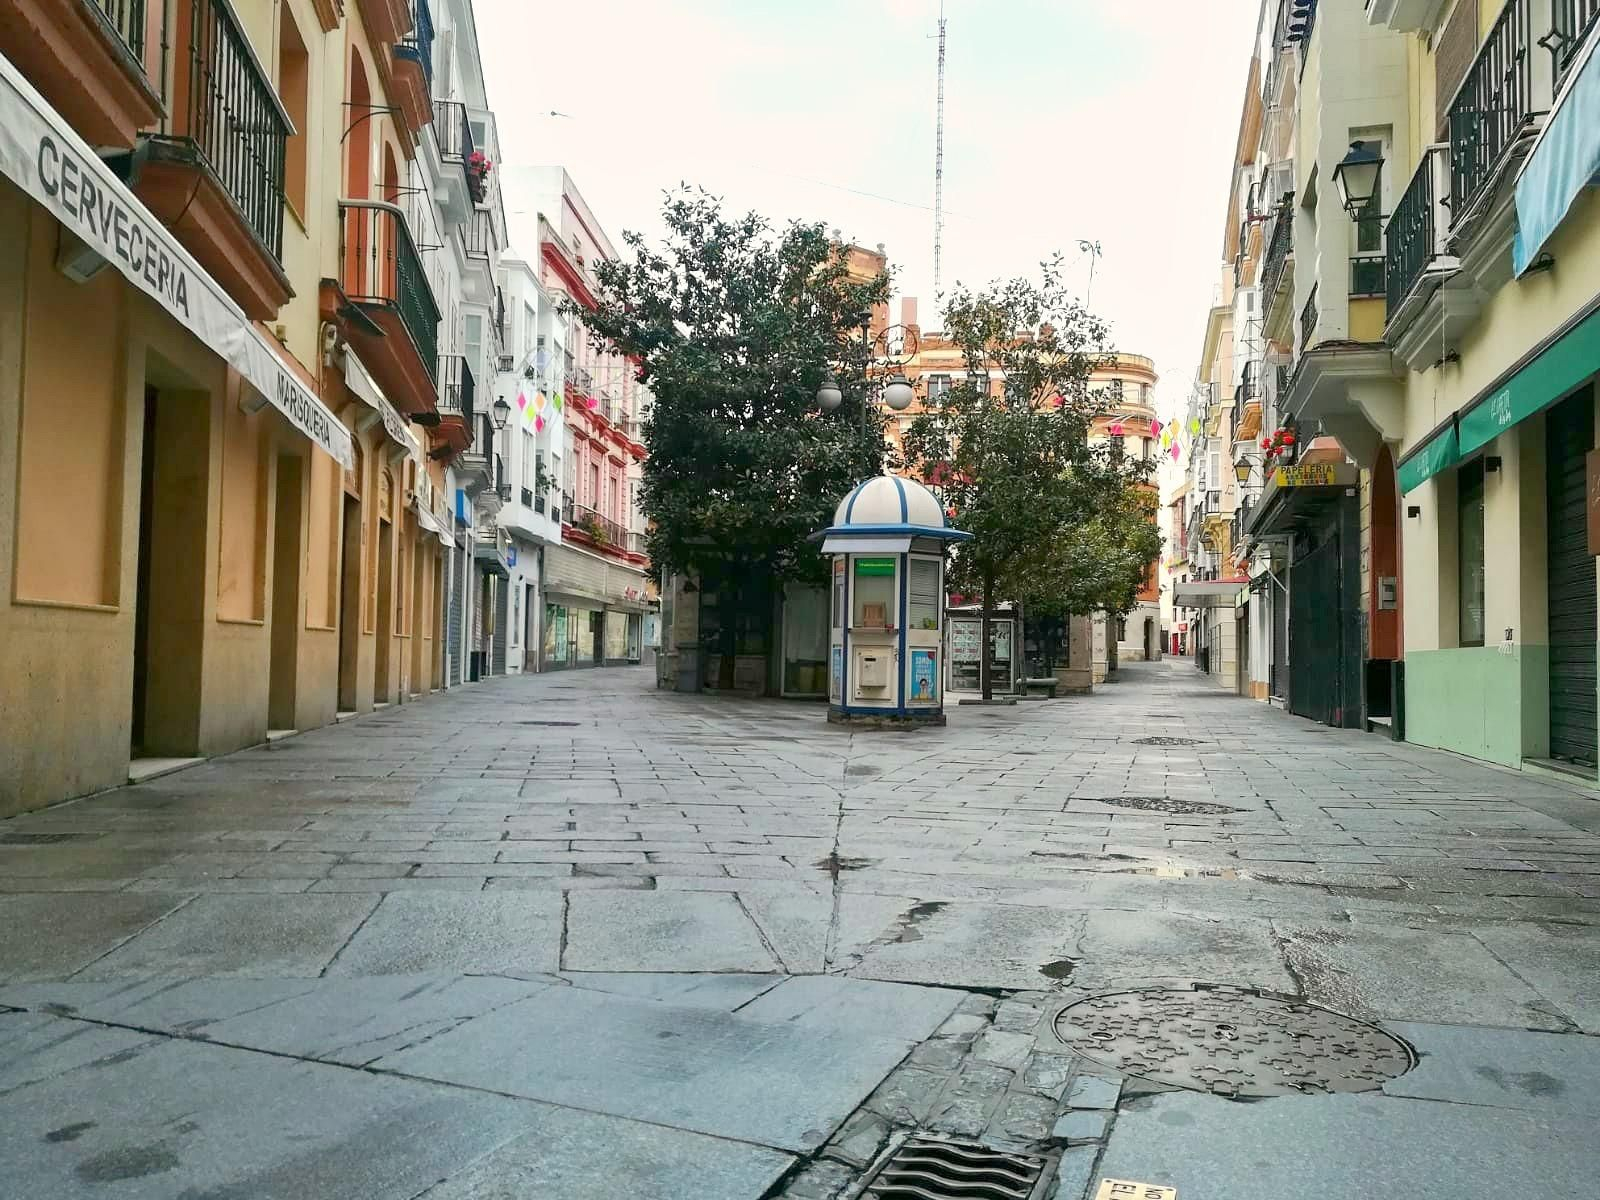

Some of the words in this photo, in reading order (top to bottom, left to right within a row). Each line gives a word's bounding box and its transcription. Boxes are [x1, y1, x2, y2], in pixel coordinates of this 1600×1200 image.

[37, 135, 190, 319] CERVECERIA
[276, 369, 332, 449] MARISQUERIA
[1280, 464, 1333, 474] PAPELERIA
